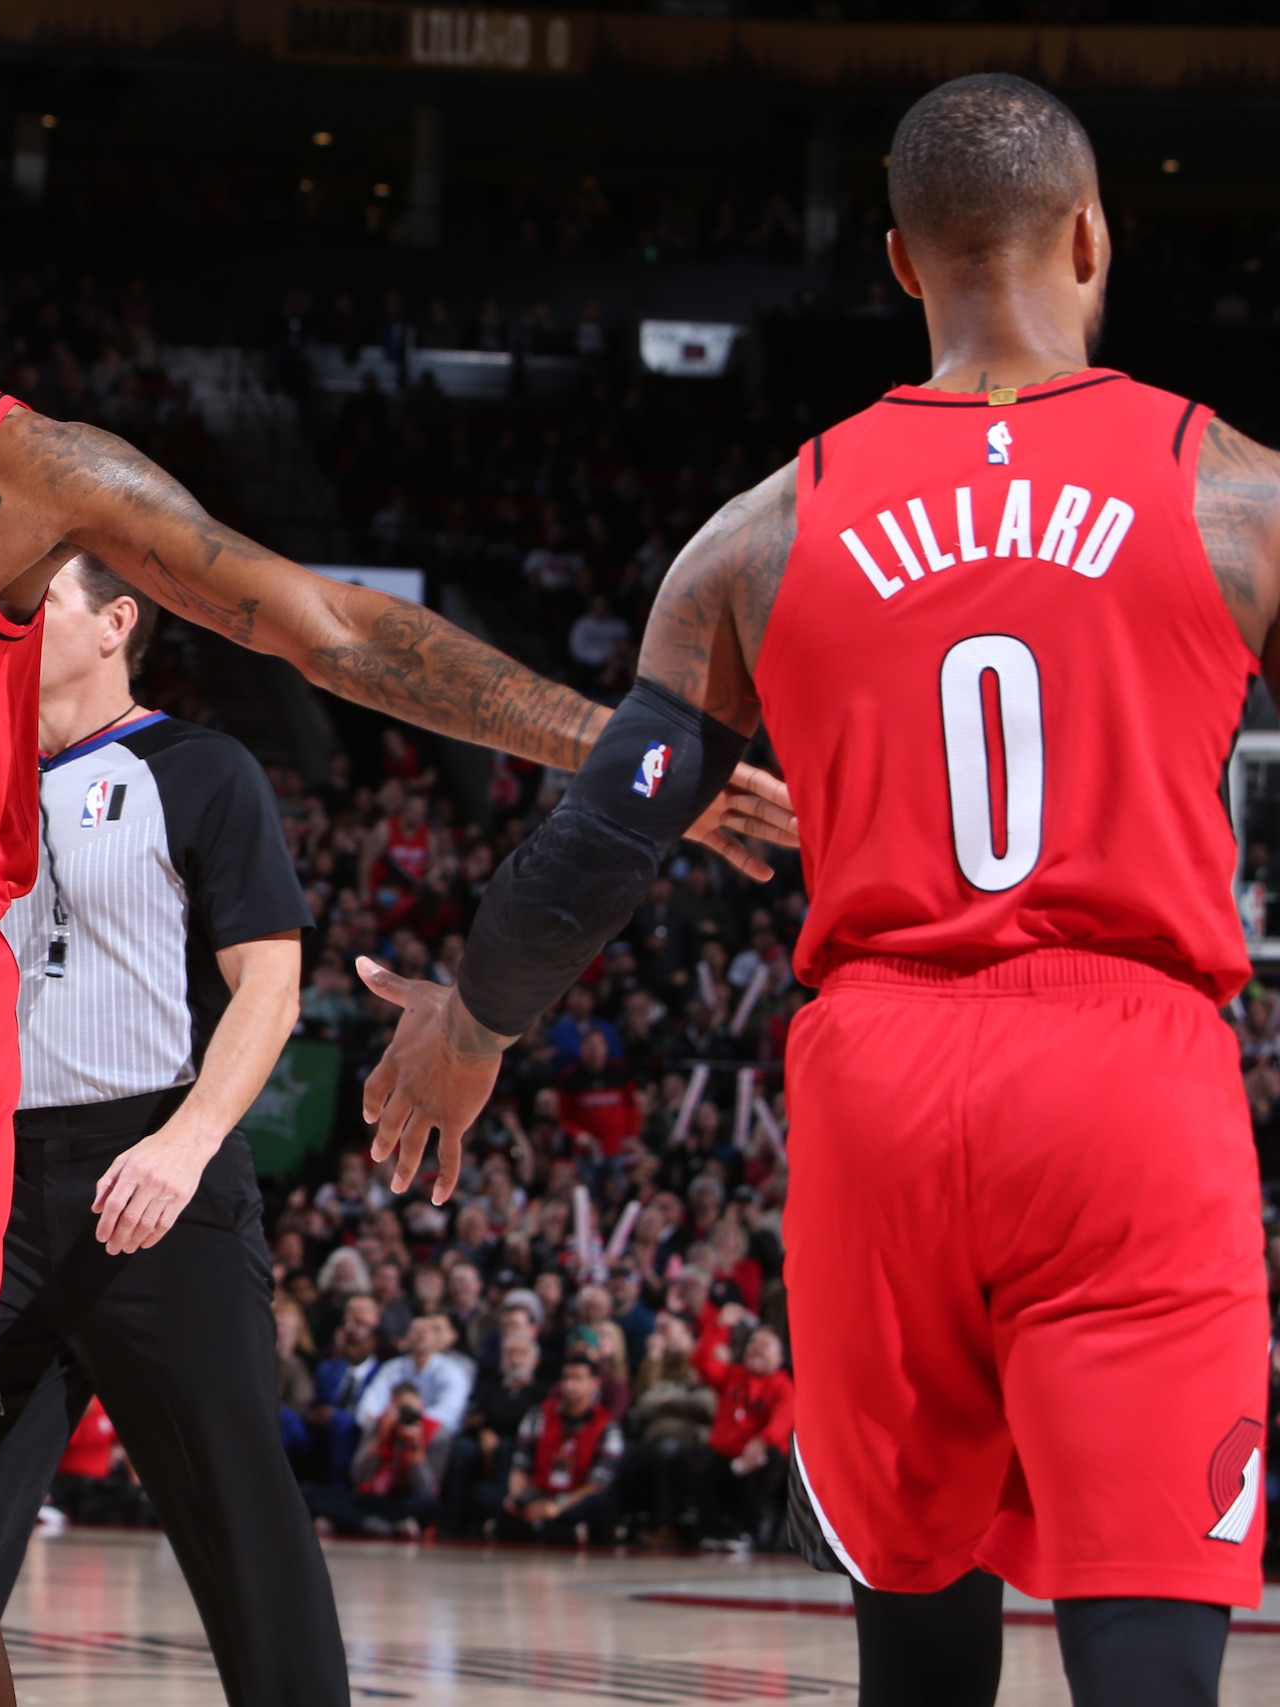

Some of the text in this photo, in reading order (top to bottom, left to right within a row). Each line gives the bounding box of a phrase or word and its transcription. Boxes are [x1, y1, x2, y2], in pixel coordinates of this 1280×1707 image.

[411, 8, 532, 68] LILLARD
[547, 17, 571, 70] 0
[839, 479, 1135, 600] LILLARD
[940, 634, 1045, 893] 0
